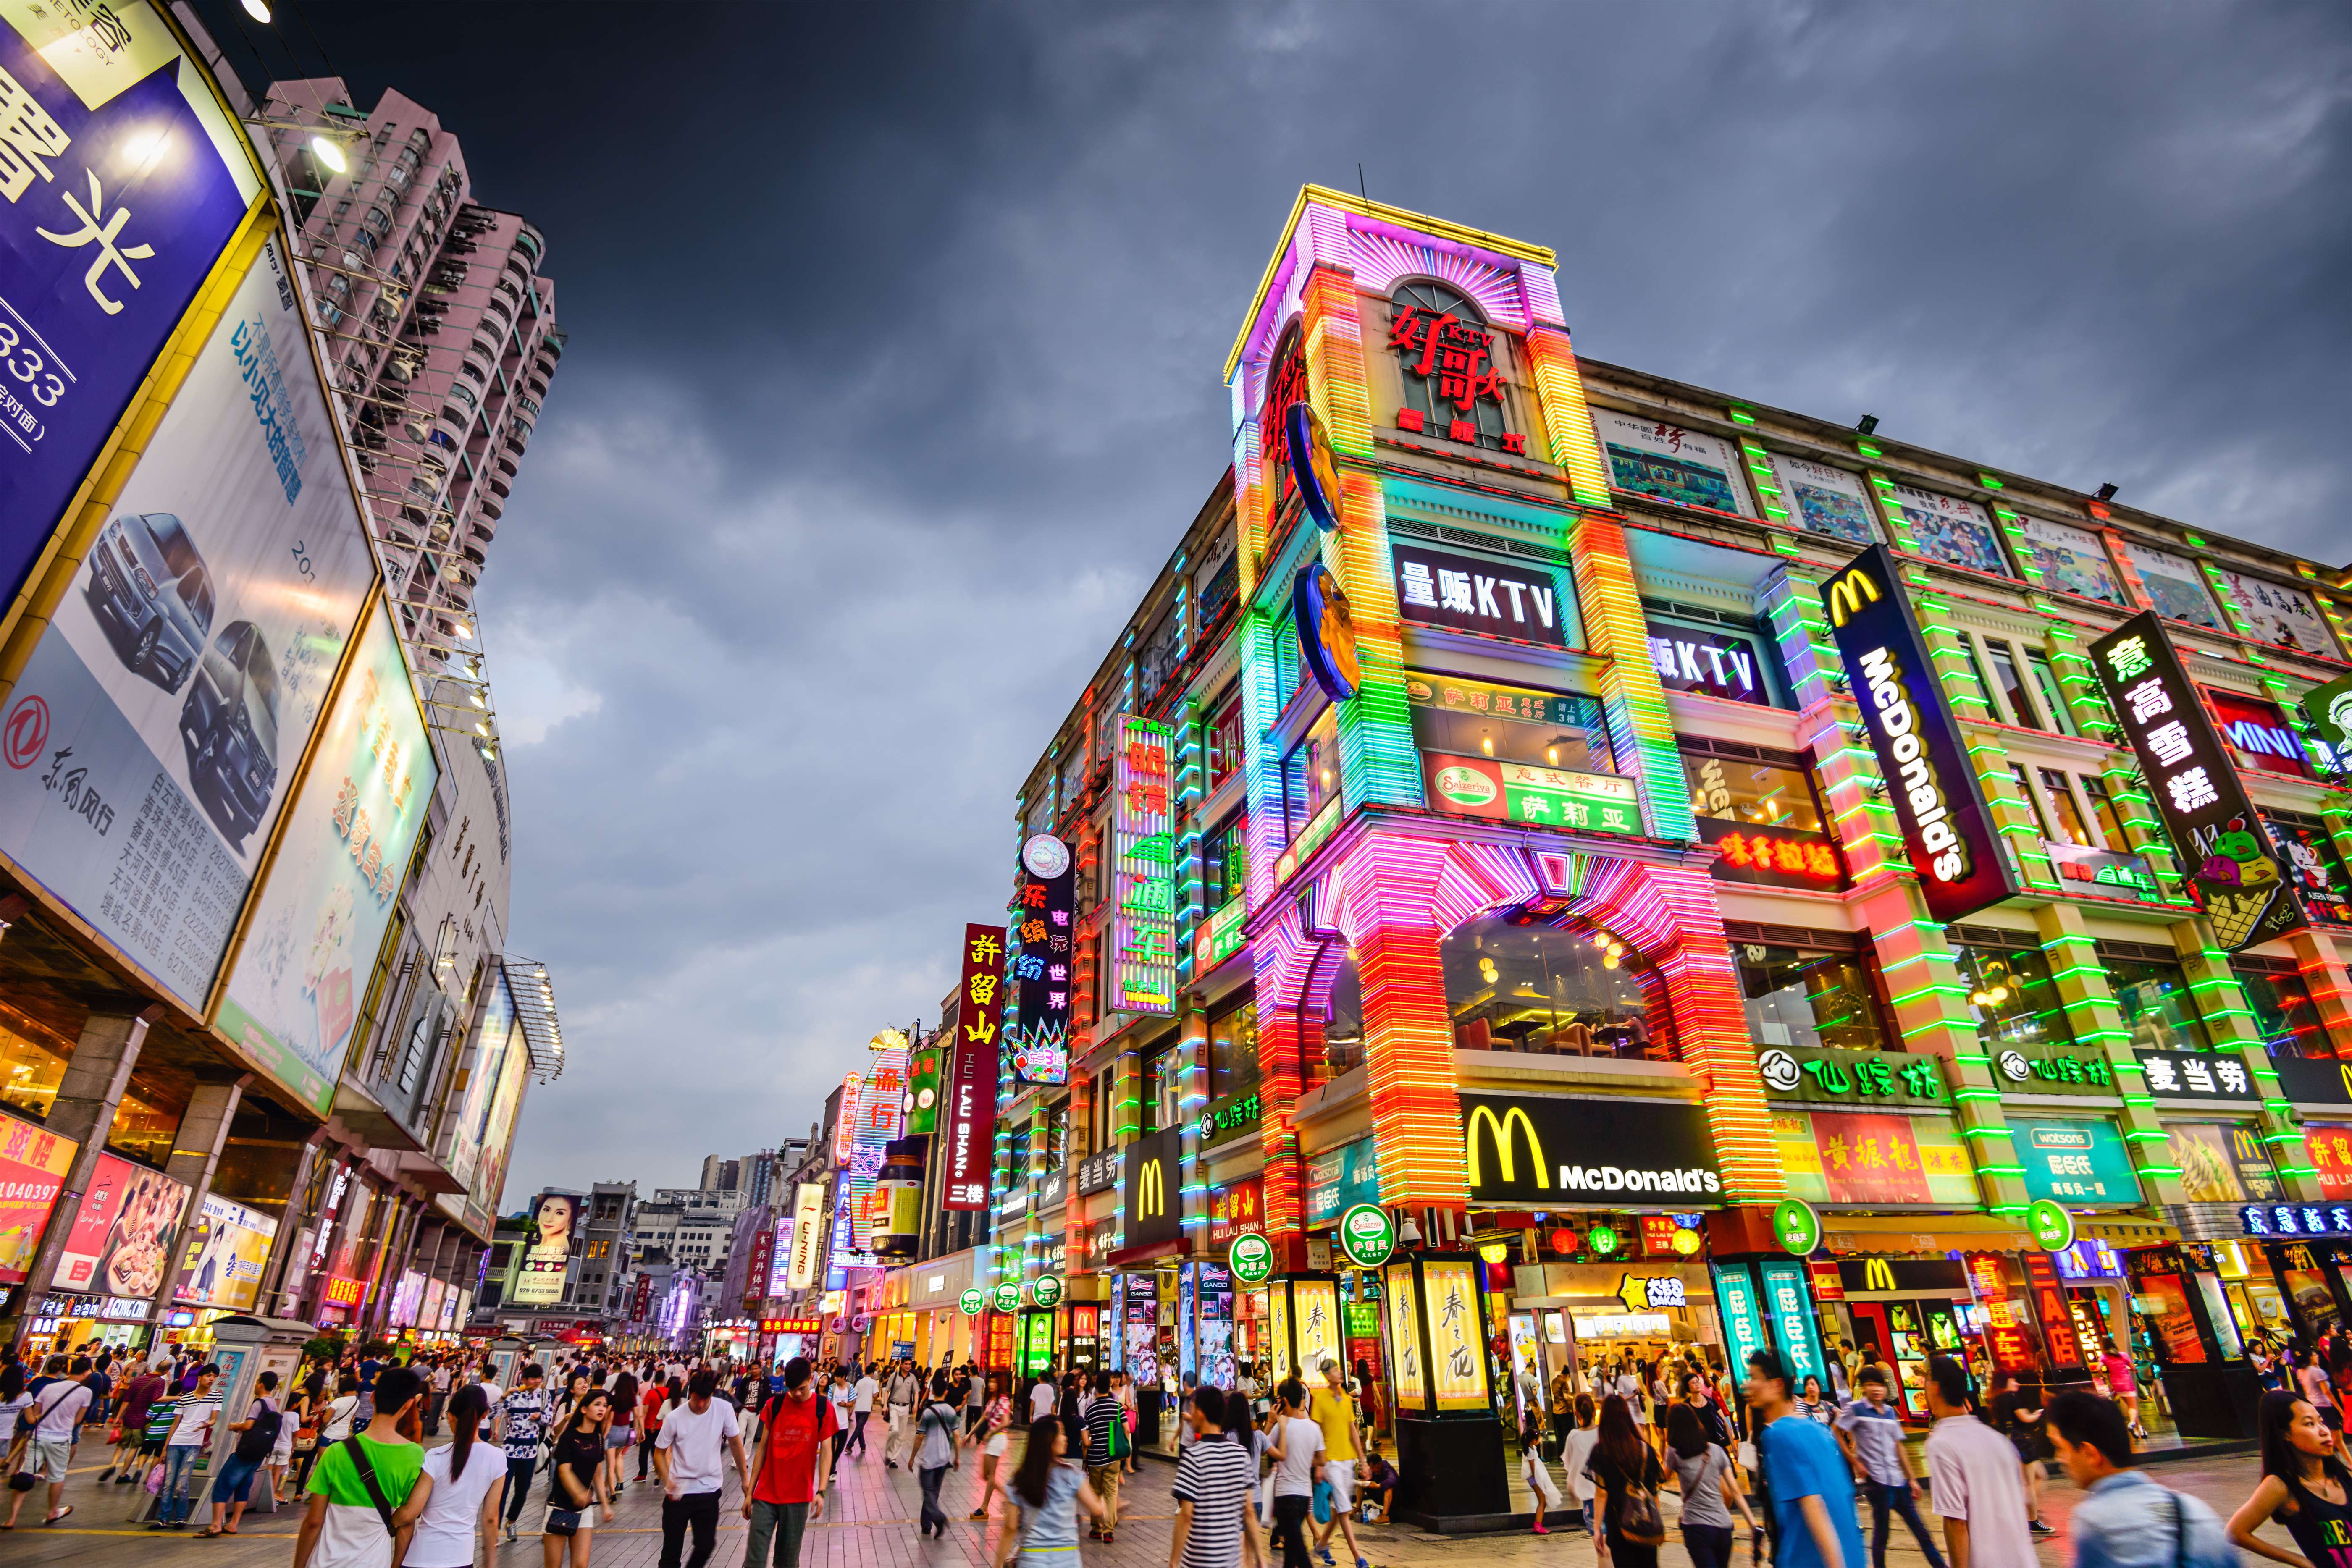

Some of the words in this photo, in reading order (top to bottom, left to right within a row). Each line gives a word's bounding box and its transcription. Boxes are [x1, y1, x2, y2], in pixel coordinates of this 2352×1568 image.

[1446, 325, 1495, 347] KTV
[231, 319, 302, 506] 以小见大的智慧
[1614, 420, 1653, 434] 中华圆
[1641, 433, 1666, 445] 百姓
[1654, 423, 1687, 454] 梦
[1681, 442, 1706, 454] 有福
[1789, 459, 1845, 482] 如今好日子
[1400, 561, 1554, 629] 量贩KTV
[1444, 687, 1517, 713] 萨莉亚
[1520, 697, 1544, 709] 意式
[1557, 701, 1576, 715] 请上
[1521, 708, 1545, 721] 餐厅
[1558, 713, 1576, 724] 3楼
[2107, 635, 2220, 814] 意高雪糕
[1858, 646, 1965, 883] McDonald's
[1129, 742, 1167, 817] 眼镜
[1442, 774, 1491, 794] Saizeriya
[1515, 766, 1622, 794] 意式餐厅
[1521, 795, 1631, 830] 萨莉亚
[332, 775, 394, 906] 拯救生命
[210, 844, 244, 894] 28270889
[201, 865, 236, 914] 84152999
[1122, 830, 1174, 962] 直通车
[183, 908, 221, 954] 22223693
[1016, 884, 1048, 981] 乐缤纷
[1046, 909, 1070, 1010] 电玩世界
[963, 933, 1003, 1045] 許留山
[1123, 978, 1160, 994] 负夹层
[963, 1053, 974, 1080] HUI
[2142, 1056, 2248, 1093] 麦当劳
[960, 1085, 973, 1117] LAU
[840, 1085, 857, 1151] 华尔登洋服
[2038, 1132, 2086, 1145] watsons
[1080, 1152, 1117, 1190] 麦当劳
[1313, 1164, 1339, 1182] watsons
[2047, 1155, 2093, 1175] 屈臣氏
[1560, 1166, 1720, 1193] McDonald's
[2051, 1182, 2106, 1196] 商场负一层
[2315, 1174, 2336, 1185] HUI
[949, 1184, 984, 1204] 三楼
[1216, 1189, 1254, 1219] 許留山
[1315, 1186, 1340, 1211] 屈臣氏
[1213, 1227, 1224, 1239] HUI
[1226, 1226, 1239, 1238] LAU
[1354, 1219, 1382, 1232] Saizeriya
[797, 1221, 811, 1275] LI-NING
[1353, 1240, 1389, 1251] 萨莉亚
[1239, 1261, 1267, 1273] 萨莉亚
[1432, 1268, 1467, 1280] 负夹层
[1300, 1286, 1328, 1295] 负夹层
[1647, 1277, 1684, 1298] 大卡司
[1649, 1294, 1686, 1307] DAKASI
[764, 1319, 820, 1332] 色色婚纱摄影
[1441, 1285, 1474, 1382] 春之花
[1439, 1390, 1484, 1399] CHUNKYSHIRE
